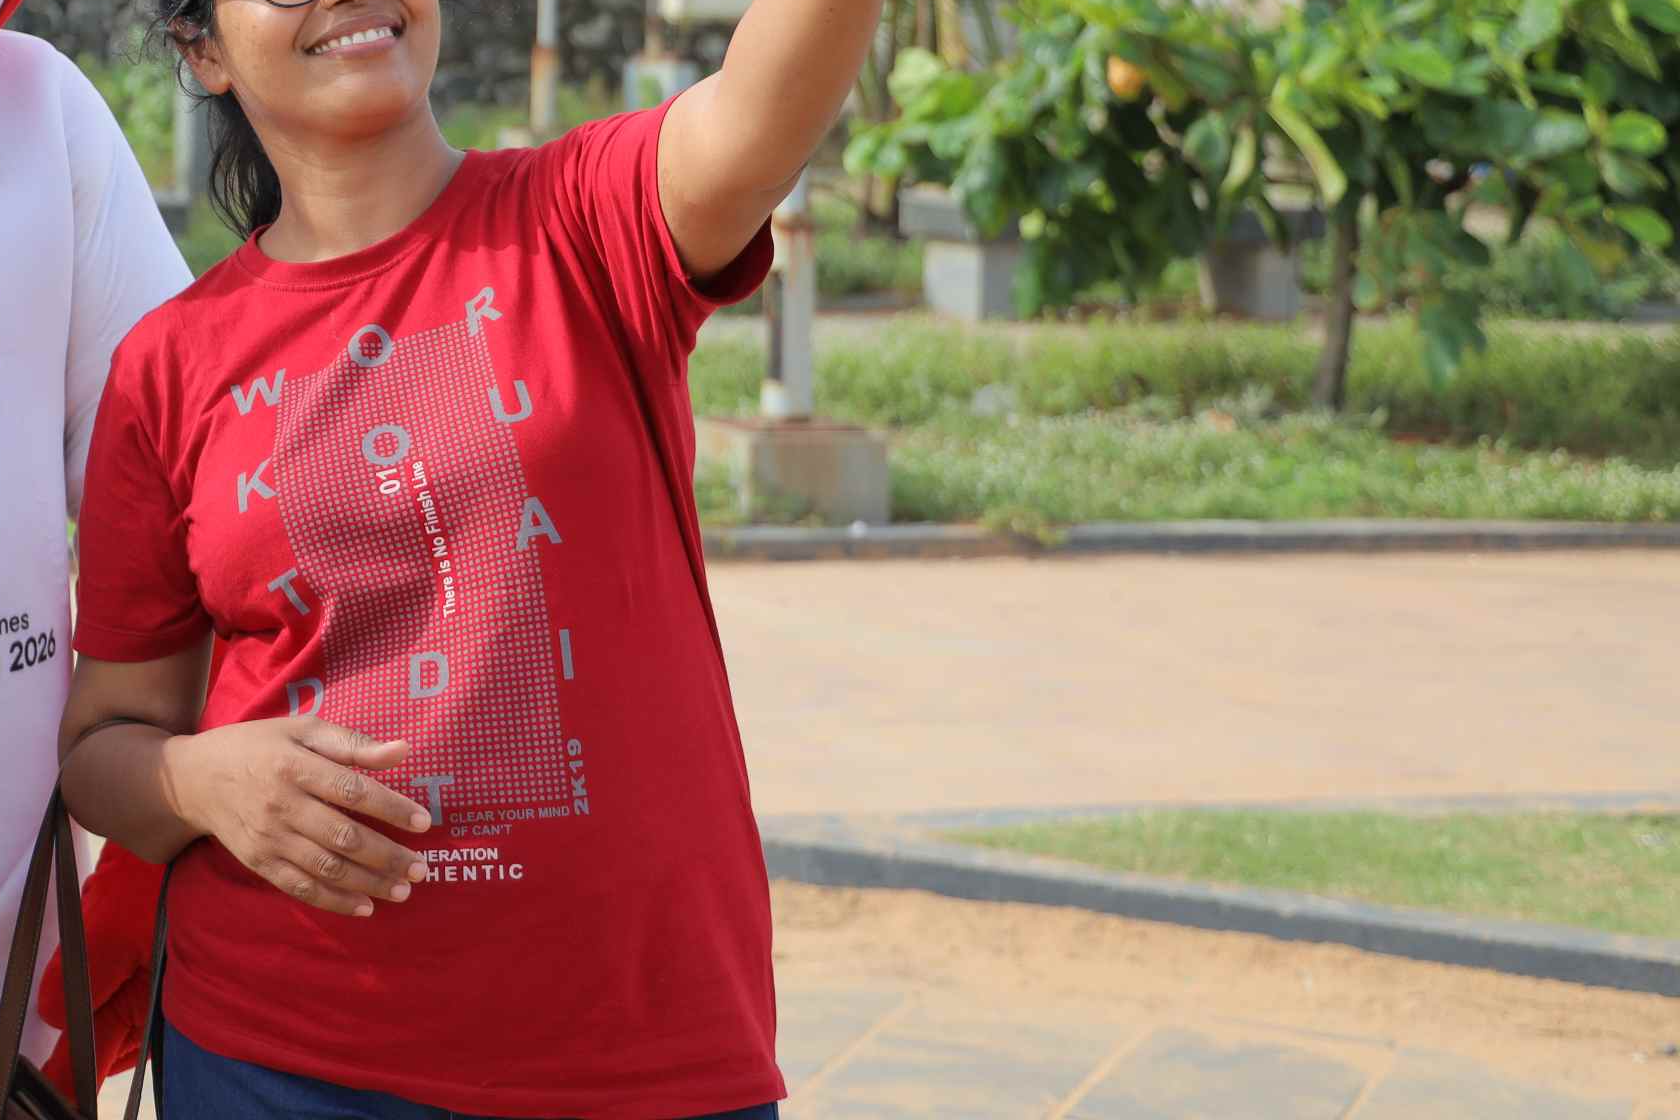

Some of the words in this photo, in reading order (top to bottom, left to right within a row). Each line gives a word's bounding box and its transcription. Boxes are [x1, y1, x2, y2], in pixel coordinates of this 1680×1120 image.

[231, 368, 286, 415] W
[464, 287, 502, 336] R
[237, 458, 277, 512] K
[487, 380, 532, 423] U
[376, 467, 401, 495] 01
[411, 461, 427, 489] Line
[416, 490, 441, 534] Finish
[267, 568, 310, 616] T
[516, 496, 562, 551] A
[431, 536, 448, 558] No
[442, 576, 455, 618] There
[9, 627, 56, 673] 2026
[408, 651, 449, 699] D
[567, 738, 590, 816] 2K19
[410, 775, 455, 826] T
[449, 810, 495, 824] CLEAR
[497, 807, 535, 821] YOUR
[538, 805, 569, 818] MIND
[450, 826, 468, 837] OF
[472, 824, 512, 836] CAN'T
[416, 847, 498, 862] NERATION
[426, 863, 523, 882] HENTIC
